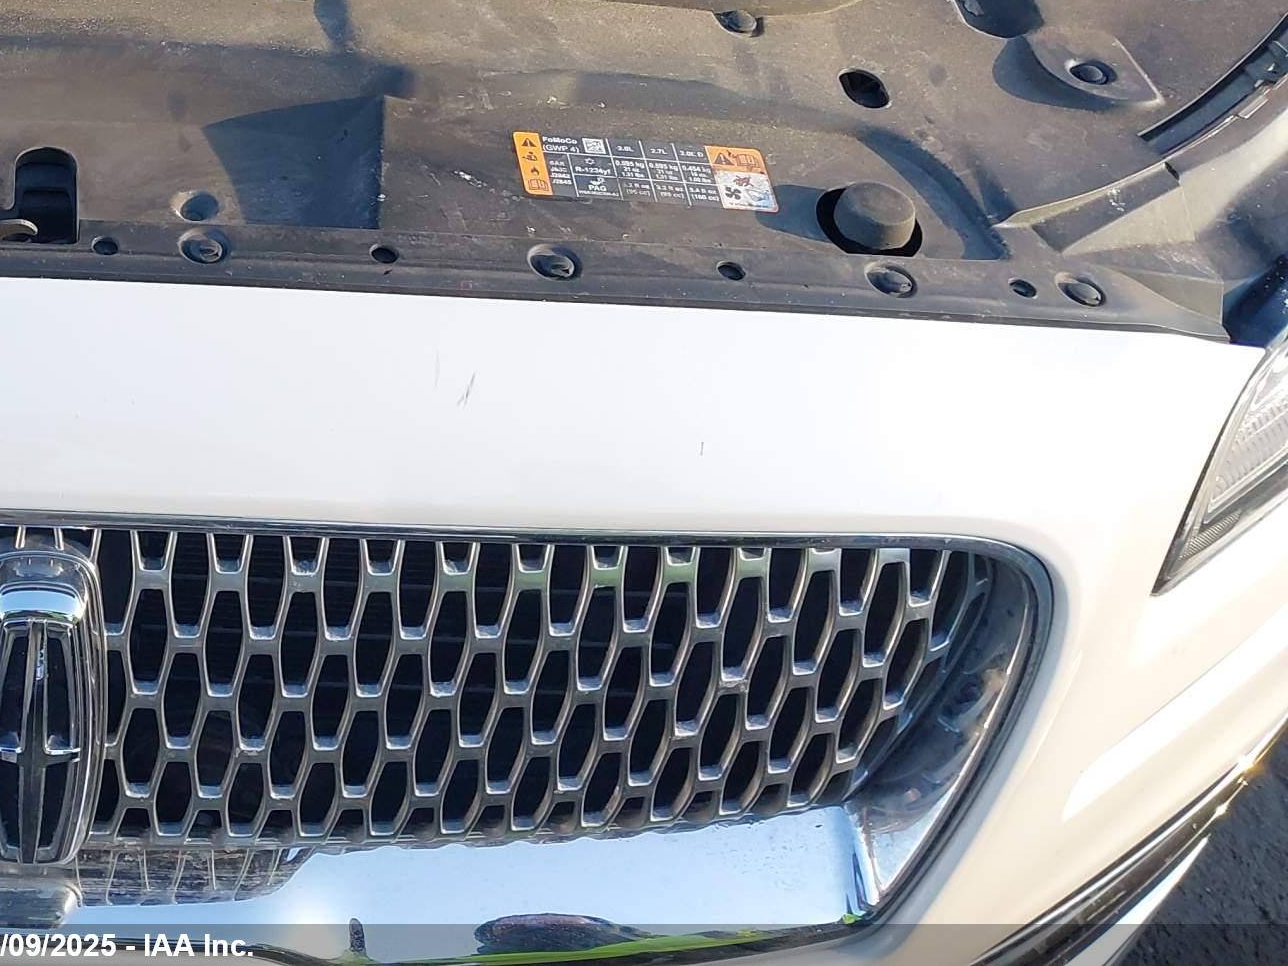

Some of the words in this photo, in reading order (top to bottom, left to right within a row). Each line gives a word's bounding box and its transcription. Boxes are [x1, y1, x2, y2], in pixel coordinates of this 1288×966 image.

[542, 136, 578, 145] FoMoCo
[543, 144, 568, 152] (GWP
[569, 146, 580, 154] 4)
[574, 166, 611, 176] R-1234yf
[587, 184, 607, 192] PAG
